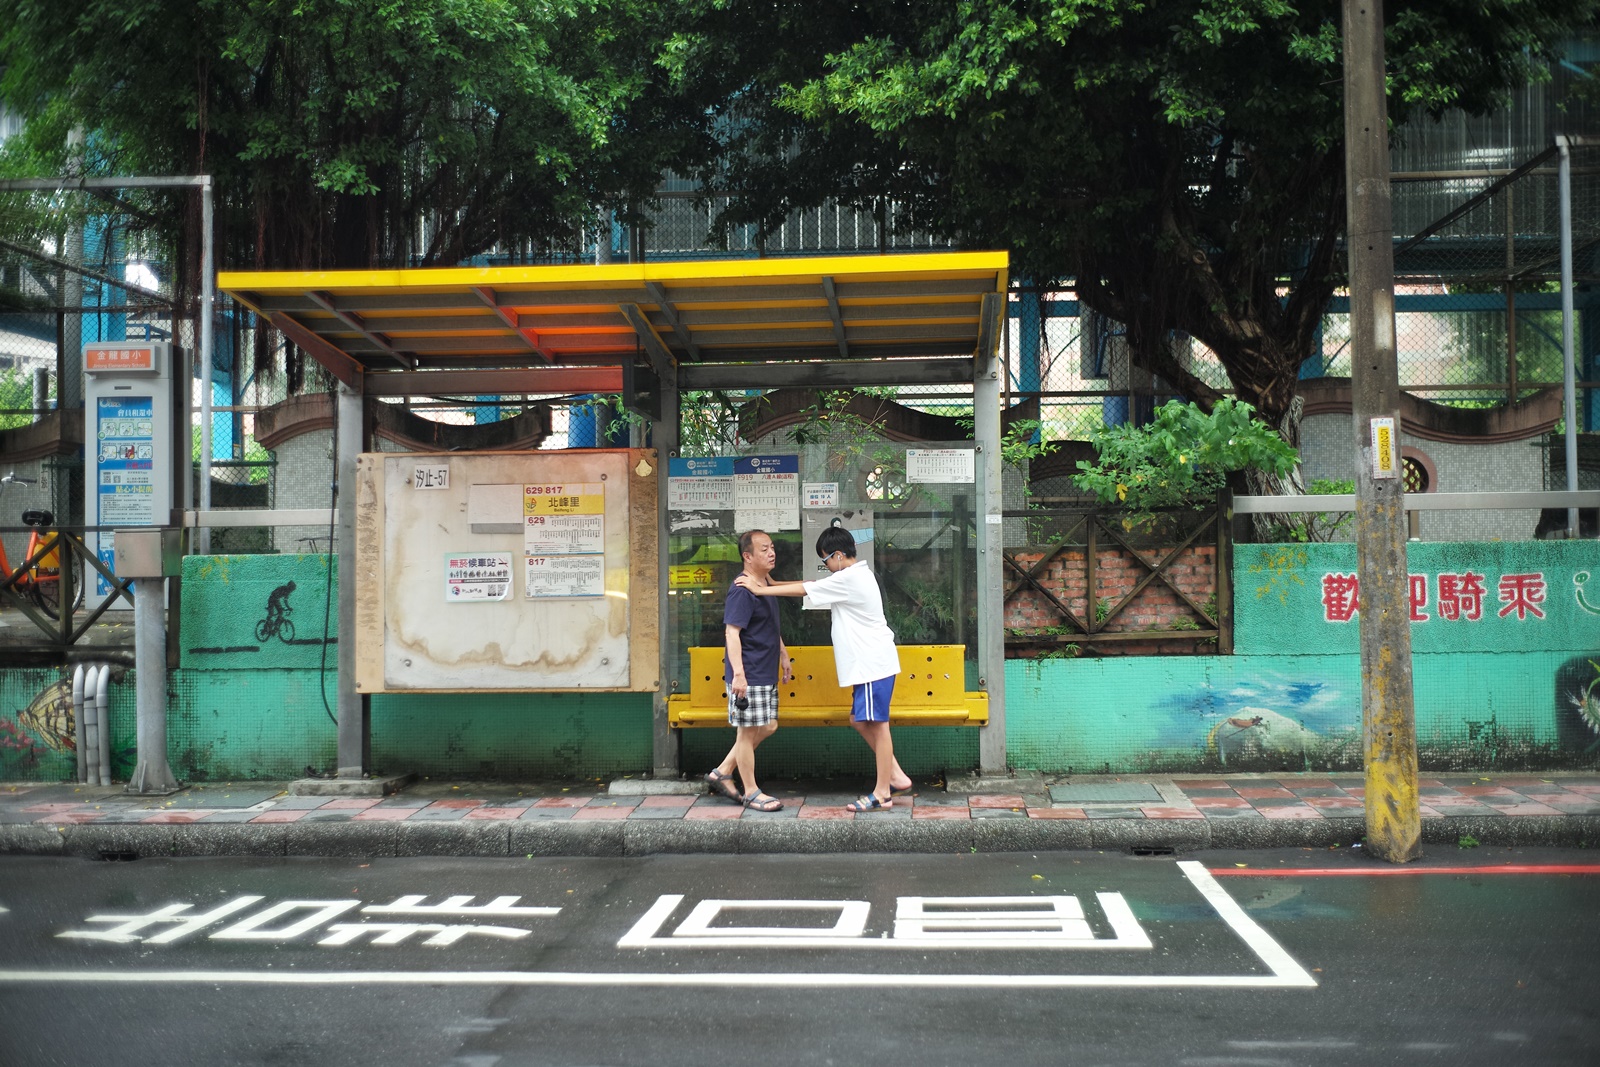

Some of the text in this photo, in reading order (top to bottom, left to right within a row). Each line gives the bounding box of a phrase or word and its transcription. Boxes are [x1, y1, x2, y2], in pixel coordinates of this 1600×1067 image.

[96, 350, 142, 360] 金龍國小
[415, 468, 447, 488] 汐止-57
[525, 486, 563, 495] 629 817
[548, 496, 580, 508] 北峰里
[528, 516, 545, 524] 629
[449, 558, 496, 568] 無菸候車站
[528, 558, 546, 566] 817
[0, 892, 1154, 949] 靠區
